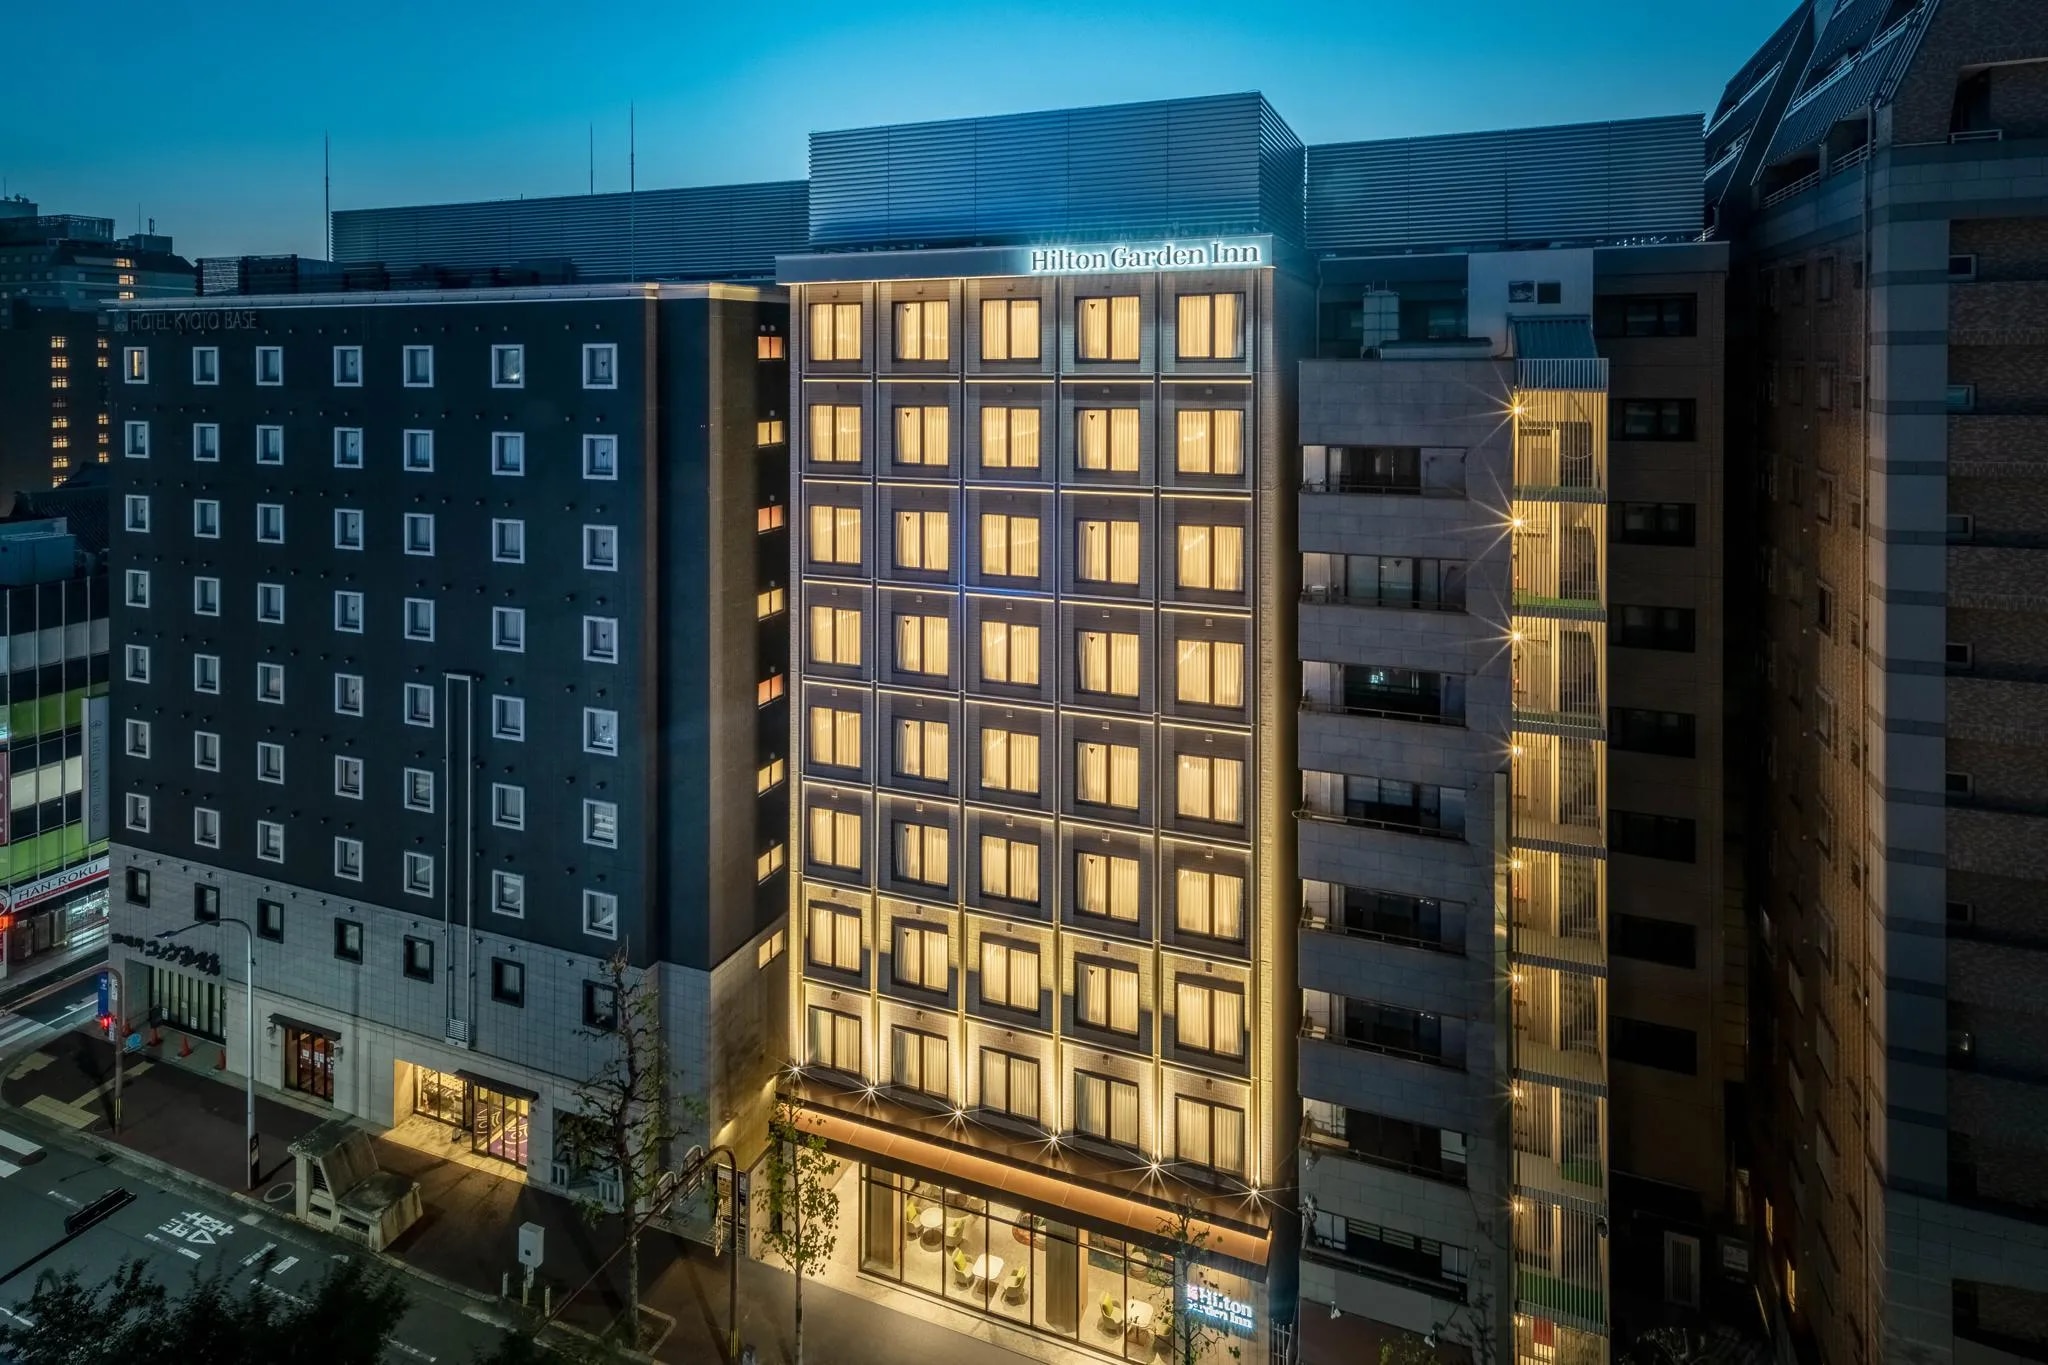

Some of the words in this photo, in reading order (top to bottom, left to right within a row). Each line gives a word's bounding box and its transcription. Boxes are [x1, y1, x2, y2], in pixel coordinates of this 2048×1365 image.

[1031, 249, 1106, 271] Hilton
[1111, 245, 1205, 268] Garden
[1211, 242, 1260, 264] Inn
[131, 312, 169, 329] HOTEL
[174, 311, 219, 330] KYOTO
[225, 311, 256, 329] BASE
[19, 864, 98, 901] HAN-ROKU
[1199, 1287, 1253, 1318] Hilton
